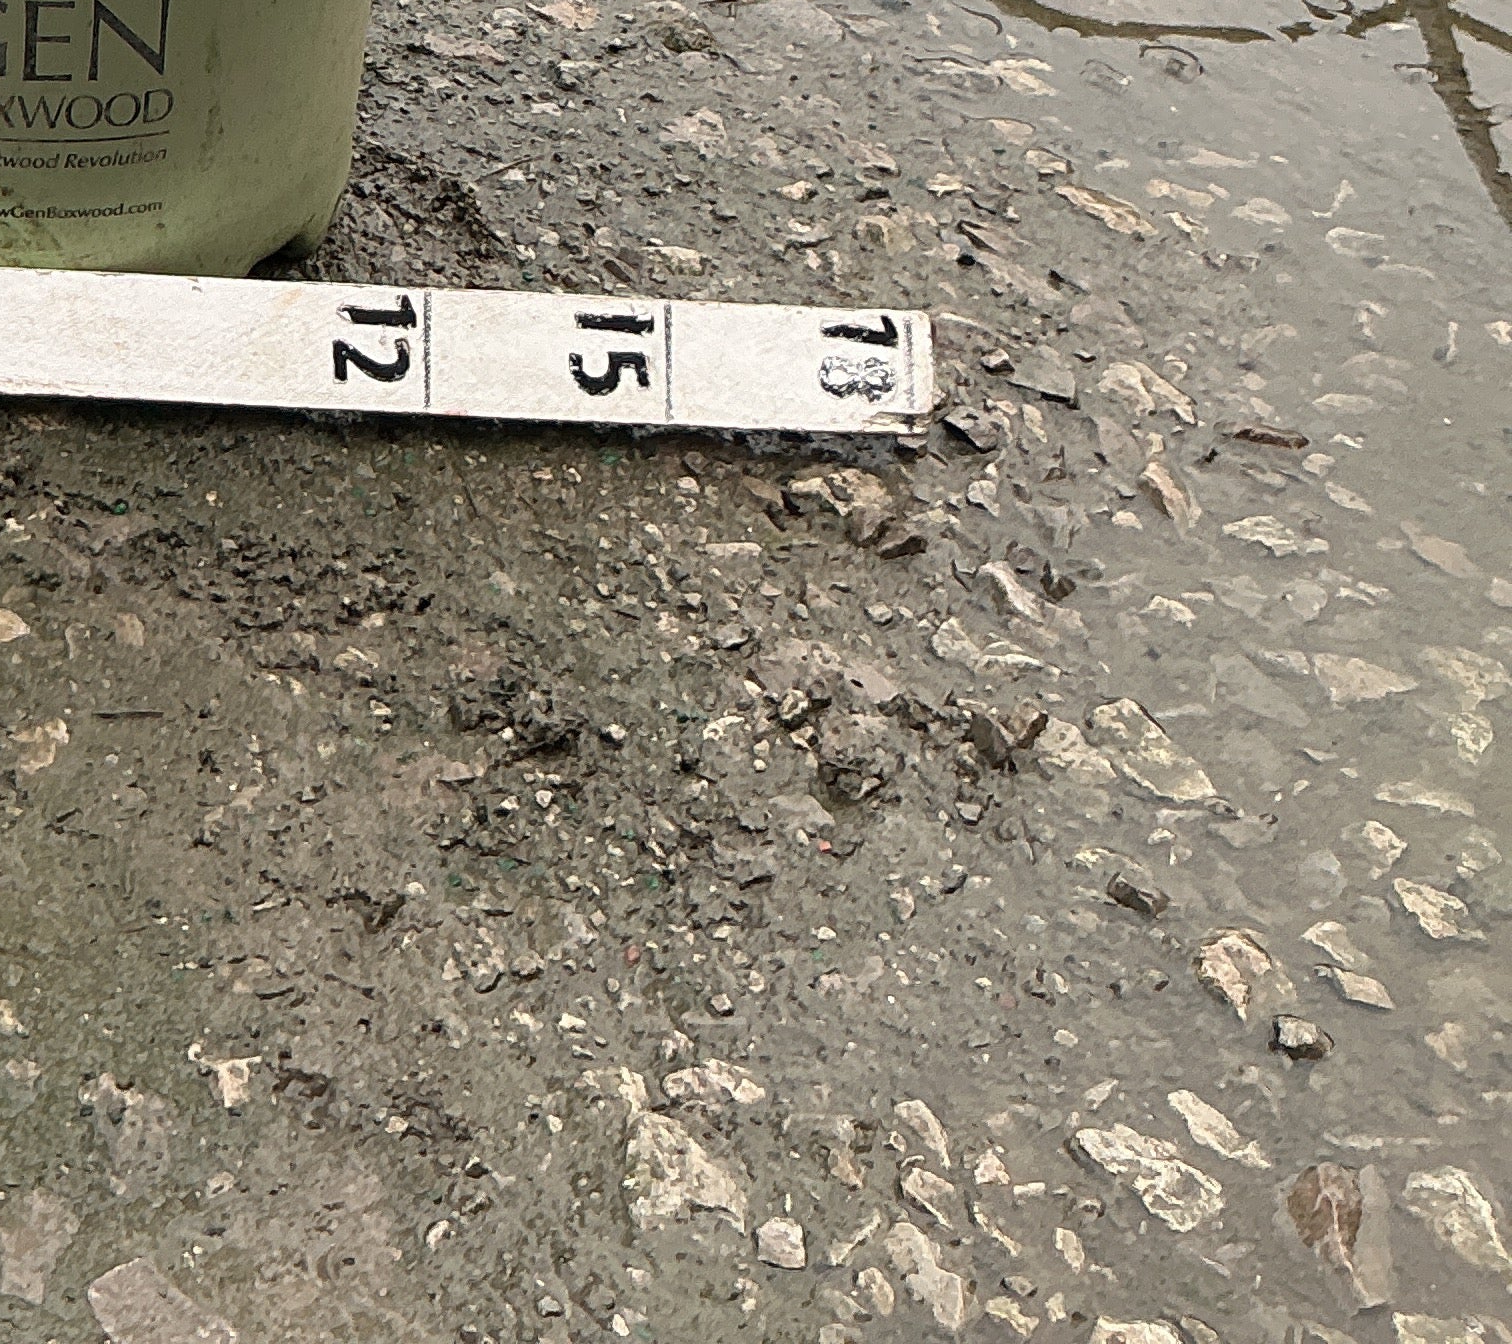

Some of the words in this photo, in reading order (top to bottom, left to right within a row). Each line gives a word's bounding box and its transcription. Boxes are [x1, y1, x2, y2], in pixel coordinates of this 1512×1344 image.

[64, 148, 168, 170] Revolution
[332, 295, 416, 384] 12
[569, 310, 654, 396] 15
[818, 316, 899, 401] 18
